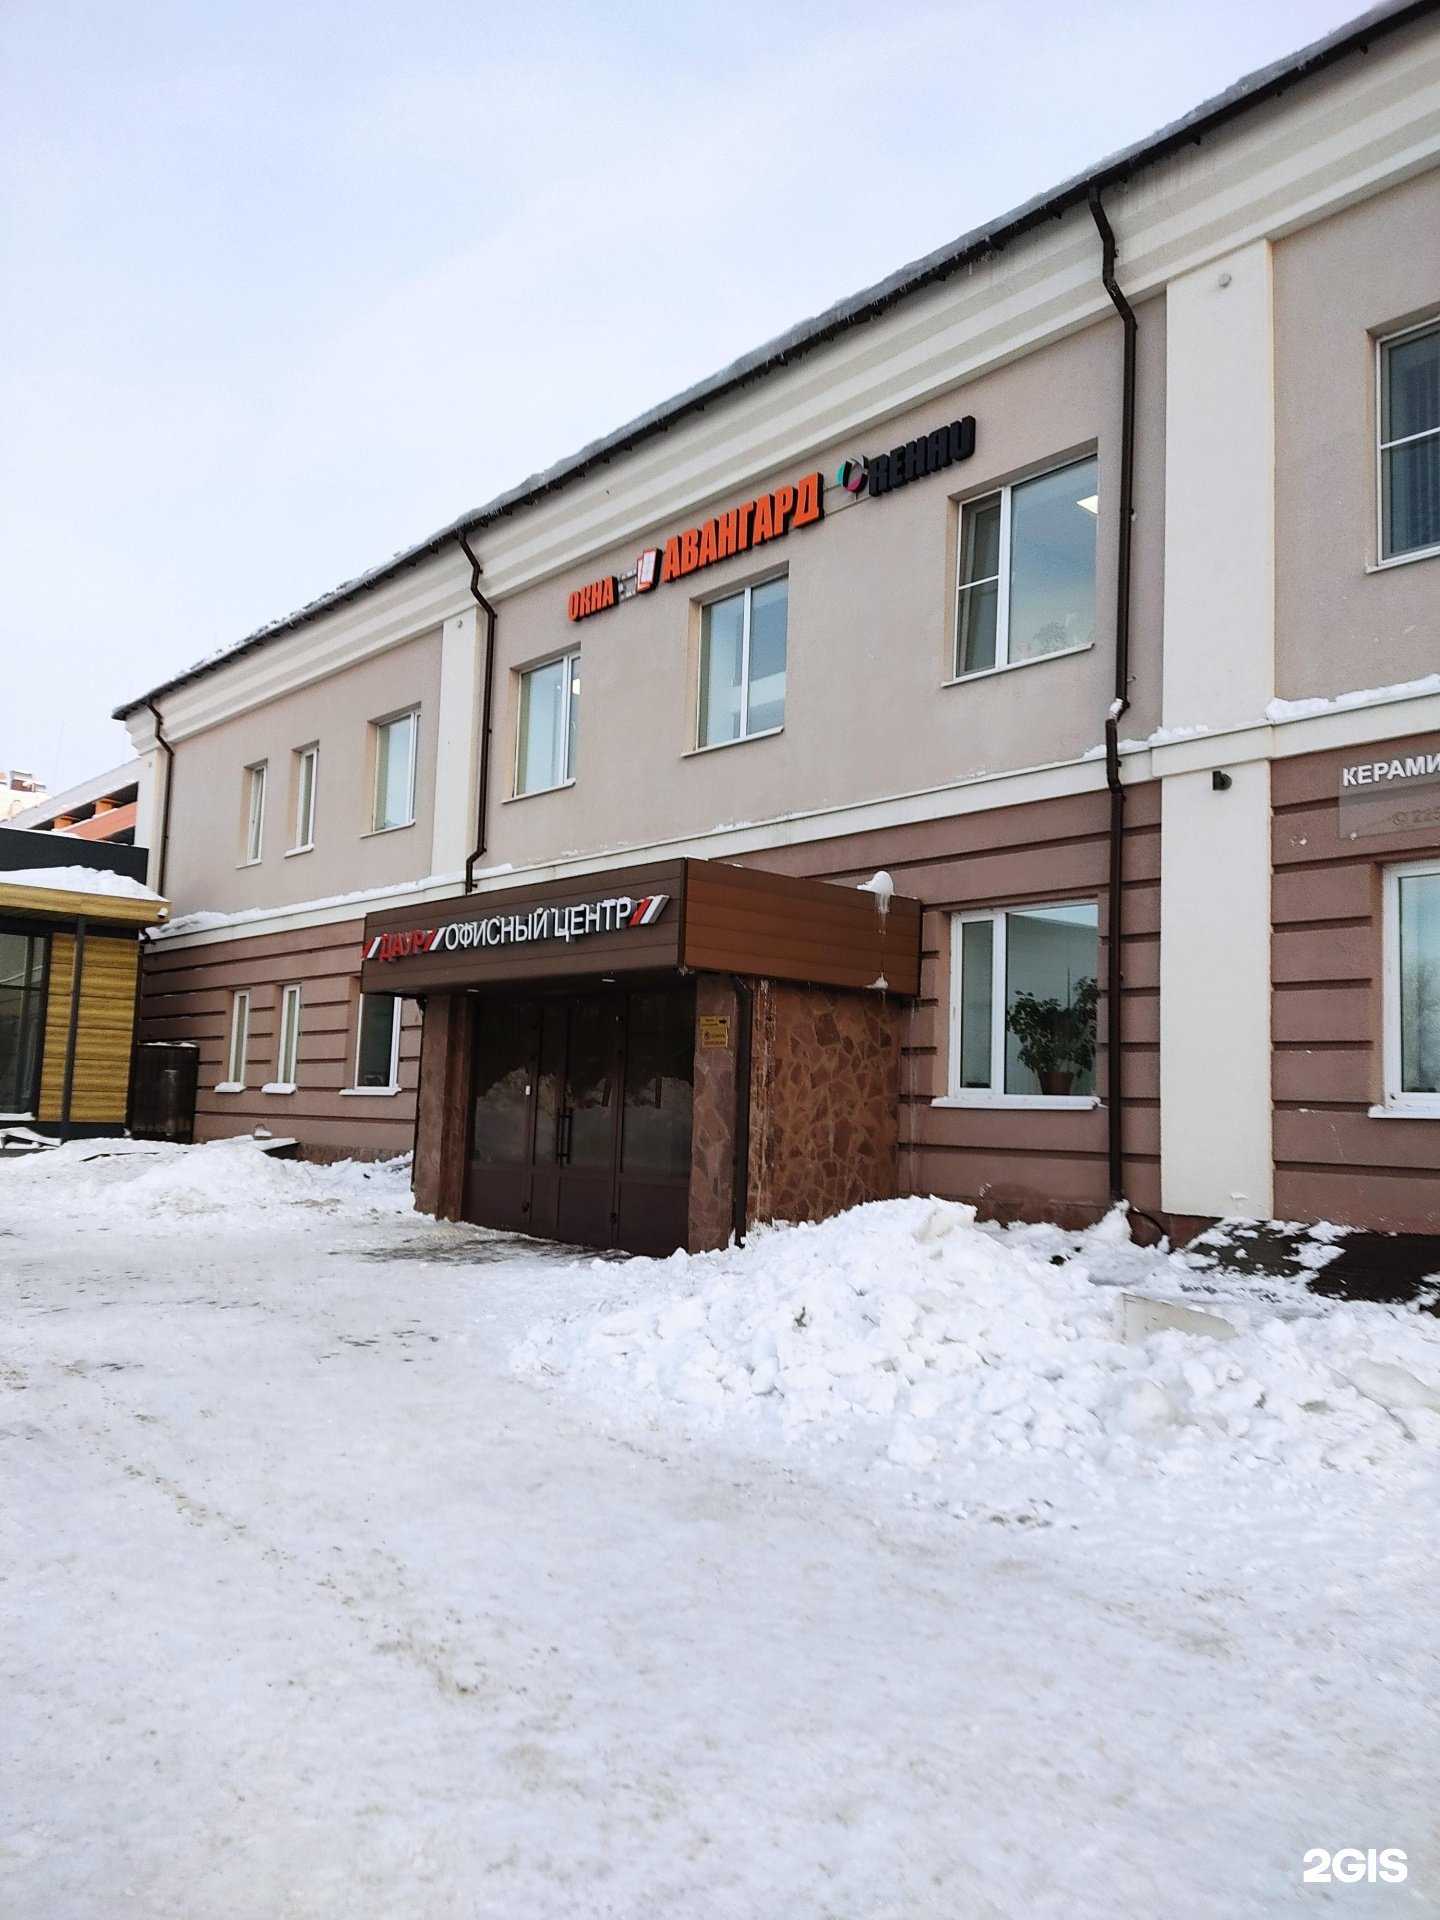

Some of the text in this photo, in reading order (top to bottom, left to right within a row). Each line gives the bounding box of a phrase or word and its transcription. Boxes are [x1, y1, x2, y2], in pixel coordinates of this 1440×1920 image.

[868, 415, 977, 498] REHAU
[568, 472, 825, 622] ОКНА АВАНГАРД
[444, 908, 550, 950] ОФИСНЫЙ
[554, 898, 633, 942] ЦЕНТР
